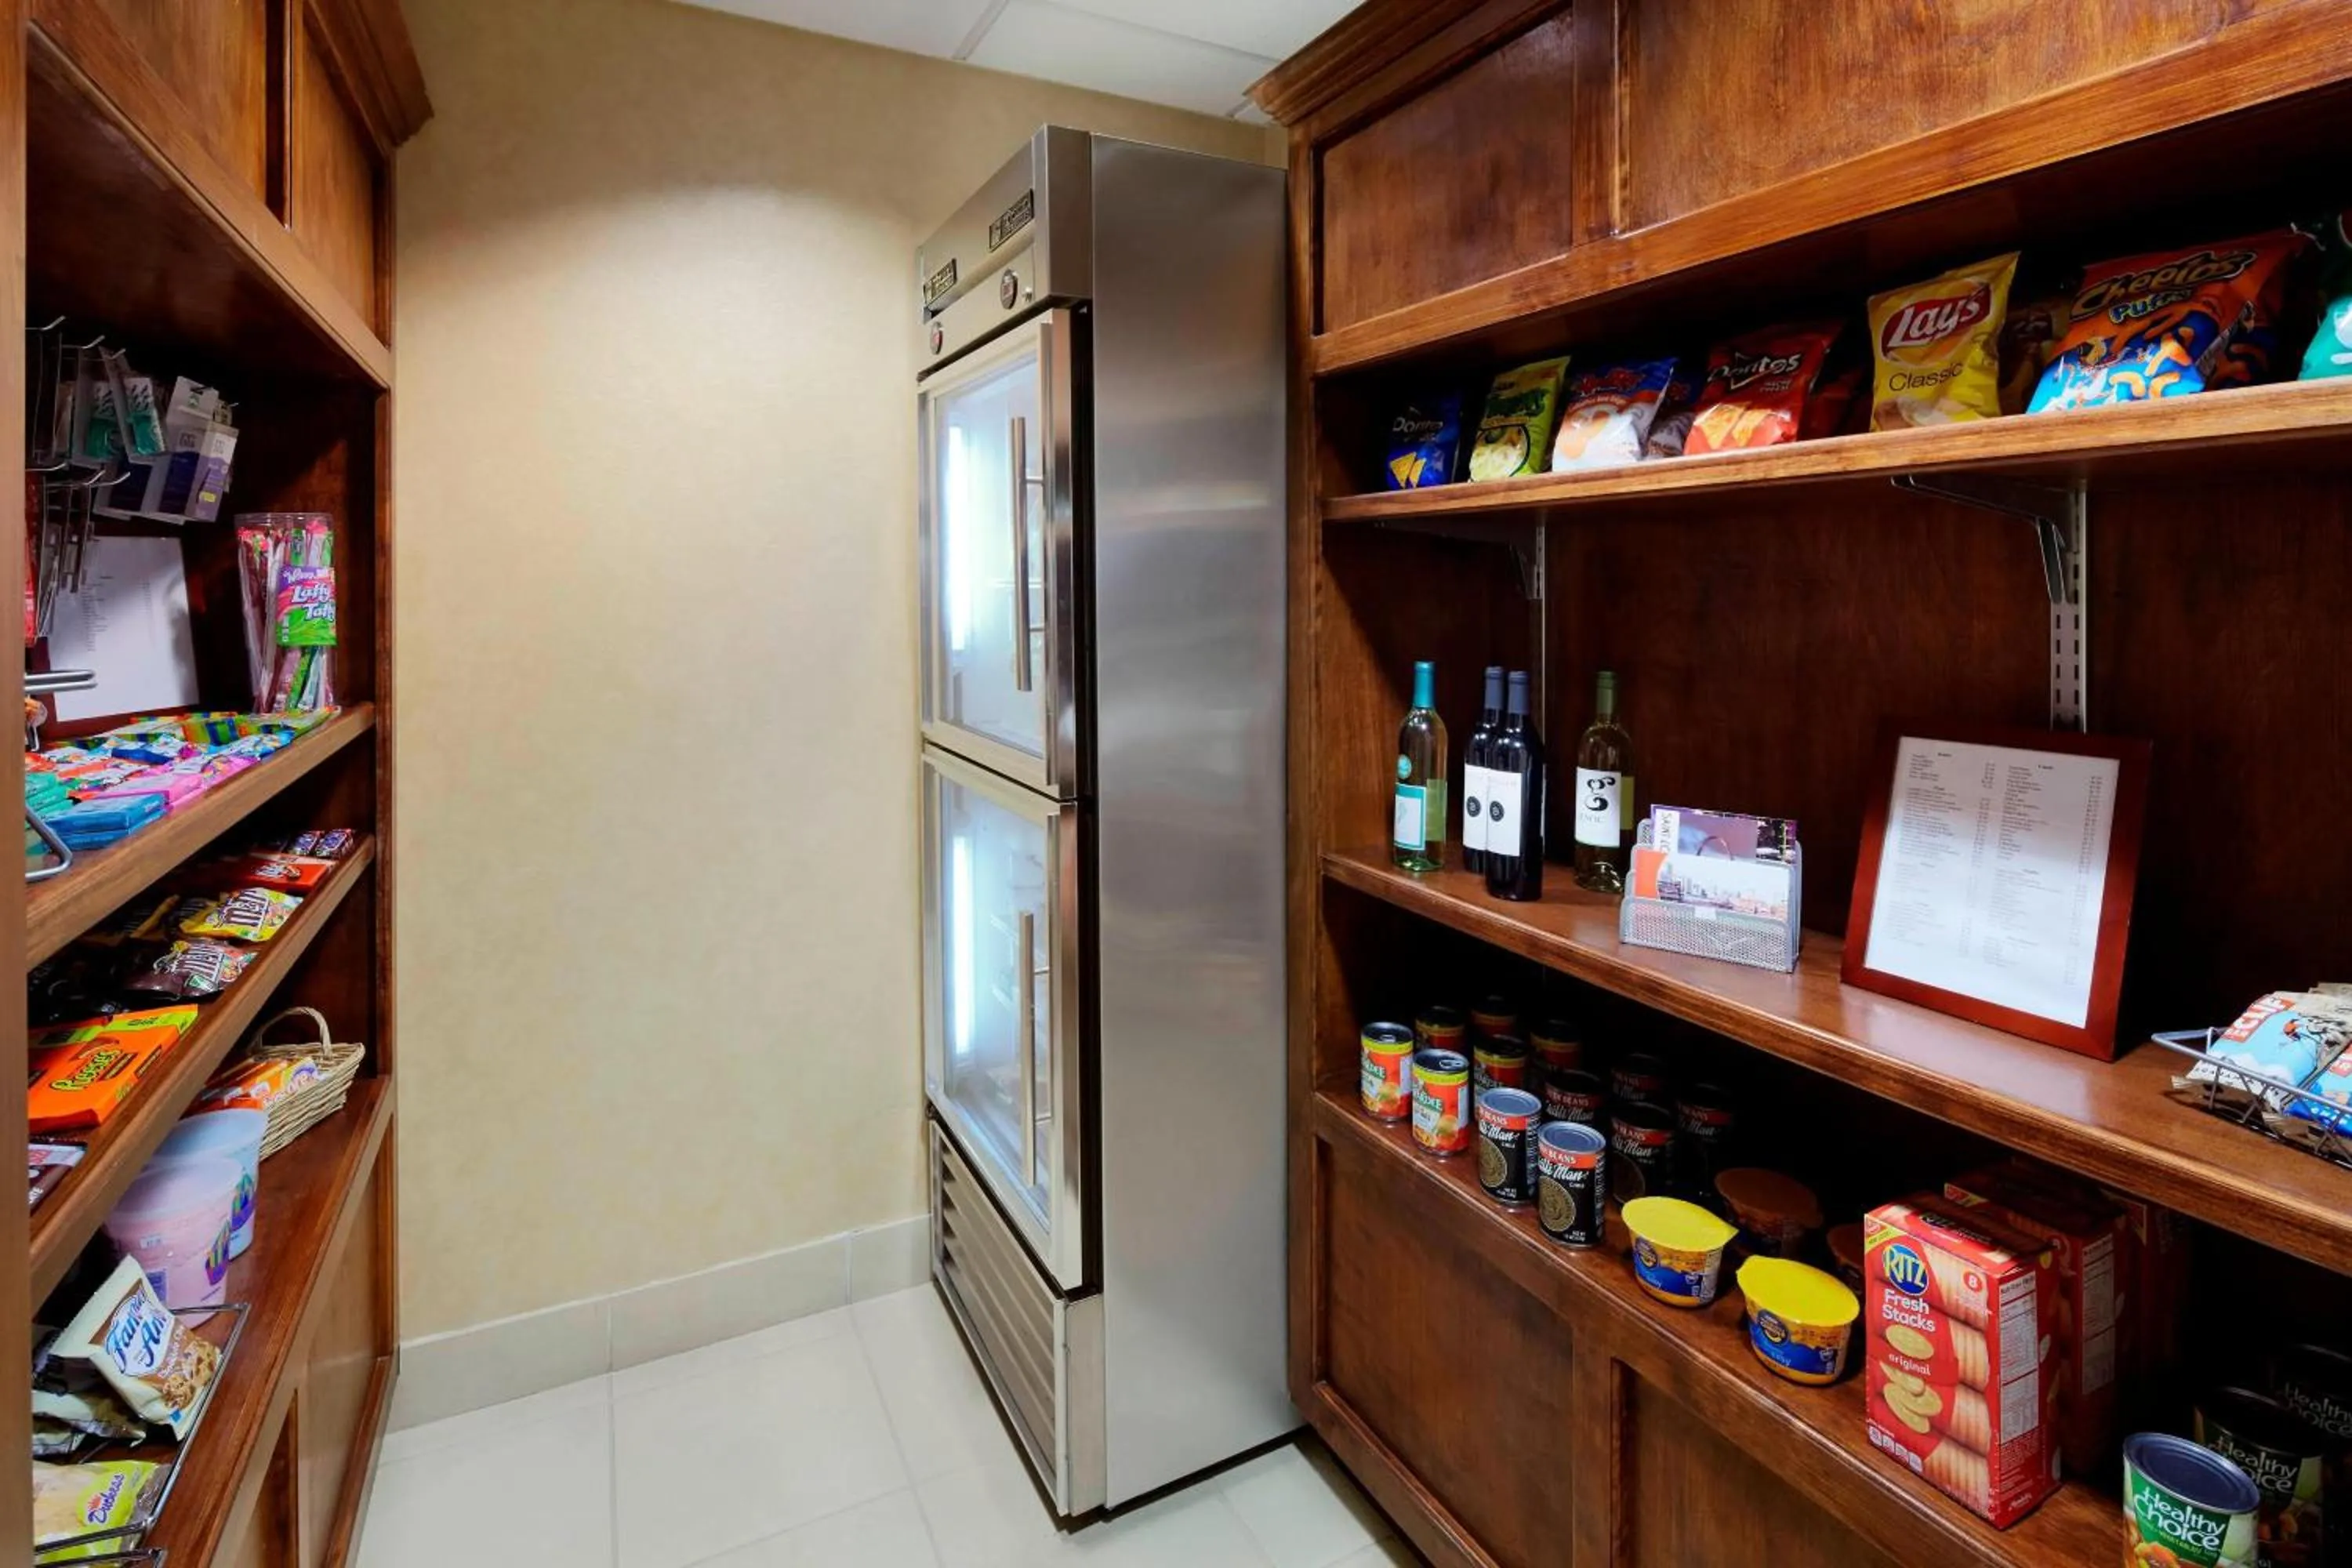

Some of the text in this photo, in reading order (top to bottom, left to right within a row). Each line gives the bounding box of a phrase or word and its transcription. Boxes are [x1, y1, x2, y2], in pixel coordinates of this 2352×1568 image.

[2071, 252, 2256, 320] Cheetos
[1887, 288, 1984, 347] Lay's
[1707, 353, 1801, 383] Doritos
[1889, 362, 1964, 391] Classic
[1554, 1164, 1588, 1181] Man
[1883, 1244, 1926, 1288] RITZ
[1968, 1272, 1978, 1287] 8
[1884, 1288, 1929, 1315] Fresh
[1882, 1304, 1936, 1332] Stacks
[1889, 1353, 1931, 1376] original
[2133, 1493, 2220, 1552] Choice
[2143, 1486, 2227, 1537] Healthy
